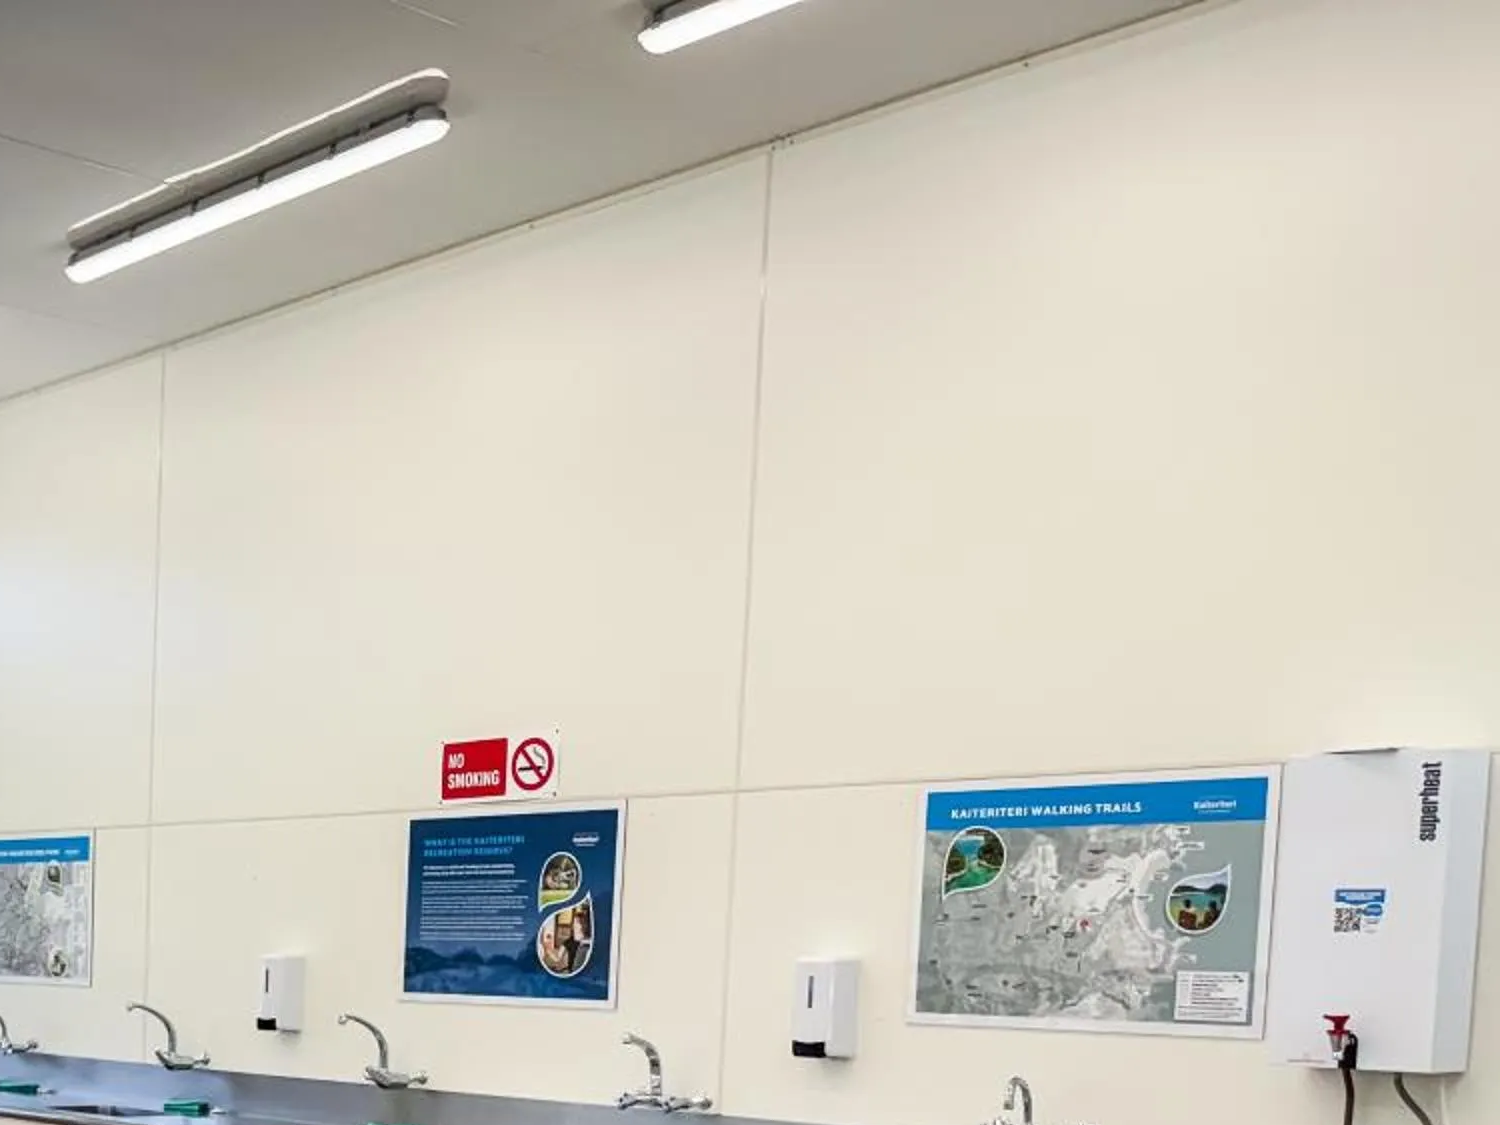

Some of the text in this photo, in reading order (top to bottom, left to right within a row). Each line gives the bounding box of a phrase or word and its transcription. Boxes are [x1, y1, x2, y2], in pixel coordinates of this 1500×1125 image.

[448, 753, 465, 769] NO
[447, 770, 500, 790] SMOKING
[951, 801, 1141, 820] KAITERITERI WALKING TRAILS
[1419, 761, 1442, 842] superheat
